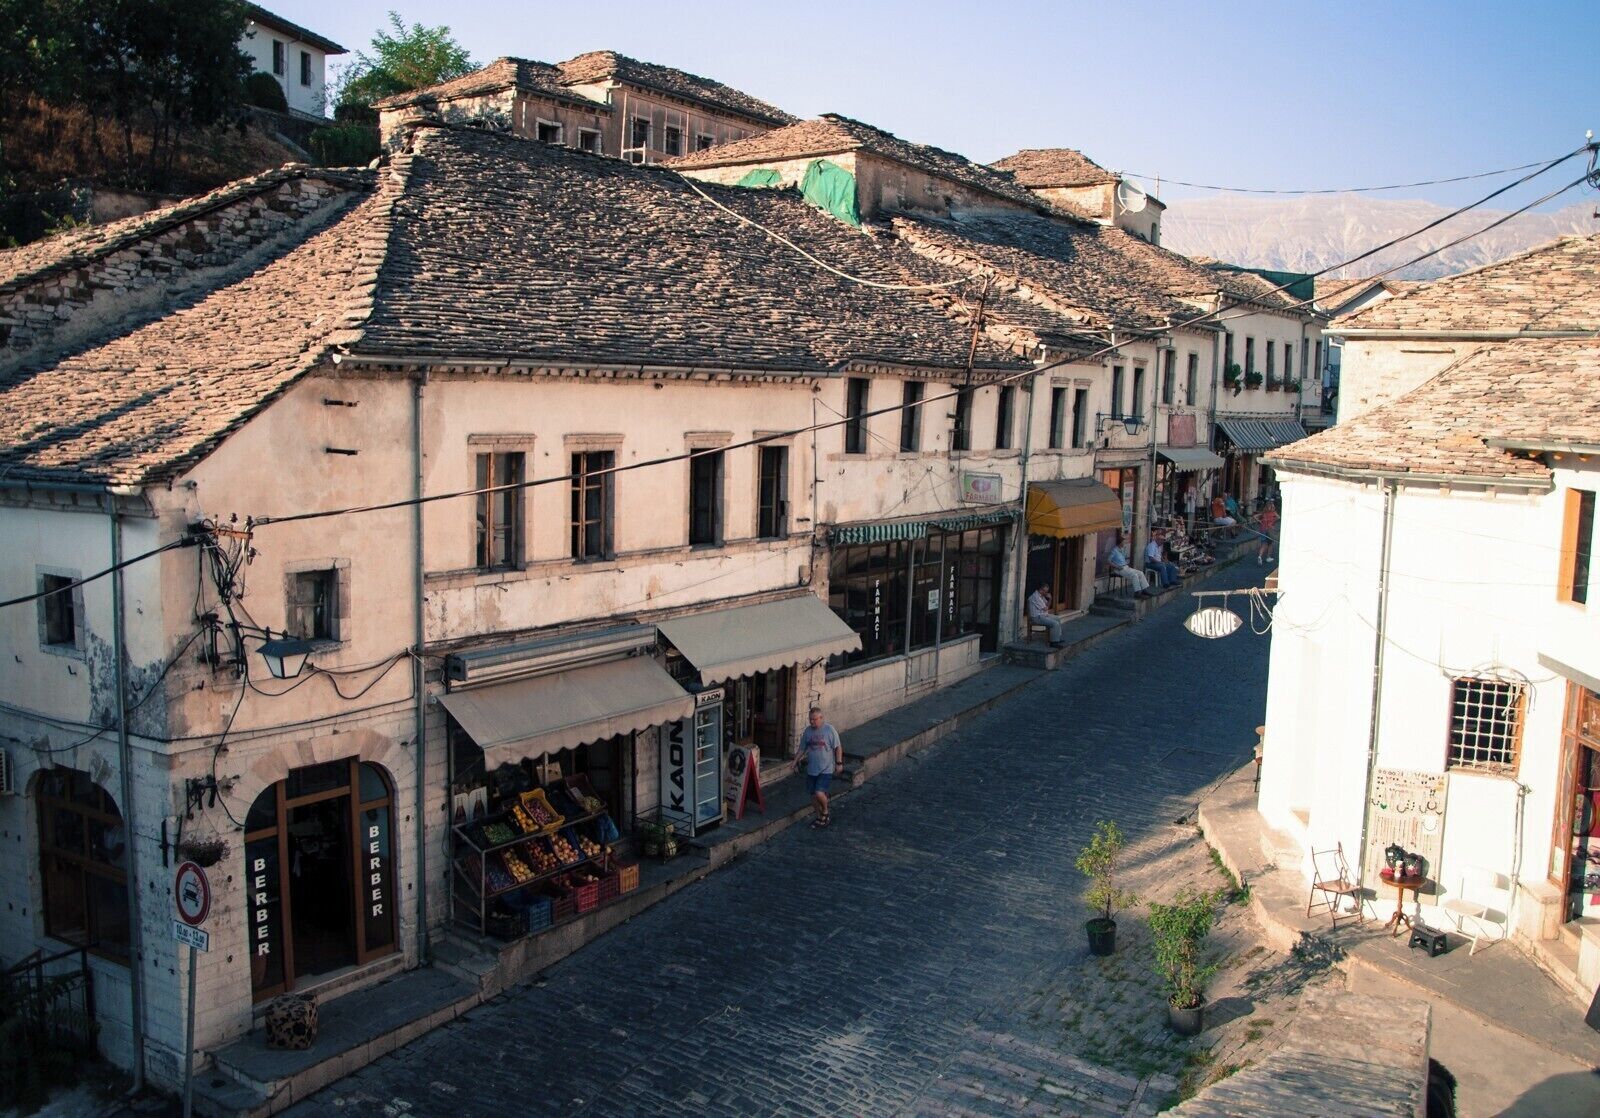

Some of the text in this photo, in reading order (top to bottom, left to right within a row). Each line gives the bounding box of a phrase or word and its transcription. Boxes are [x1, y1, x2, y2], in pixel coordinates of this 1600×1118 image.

[1190, 609, 1237, 637] ANTIQUE
[701, 692, 721, 703] KAON
[670, 721, 685, 812] KAON
[254, 858, 270, 956] BERBER
[369, 825, 383, 916] BERBER
